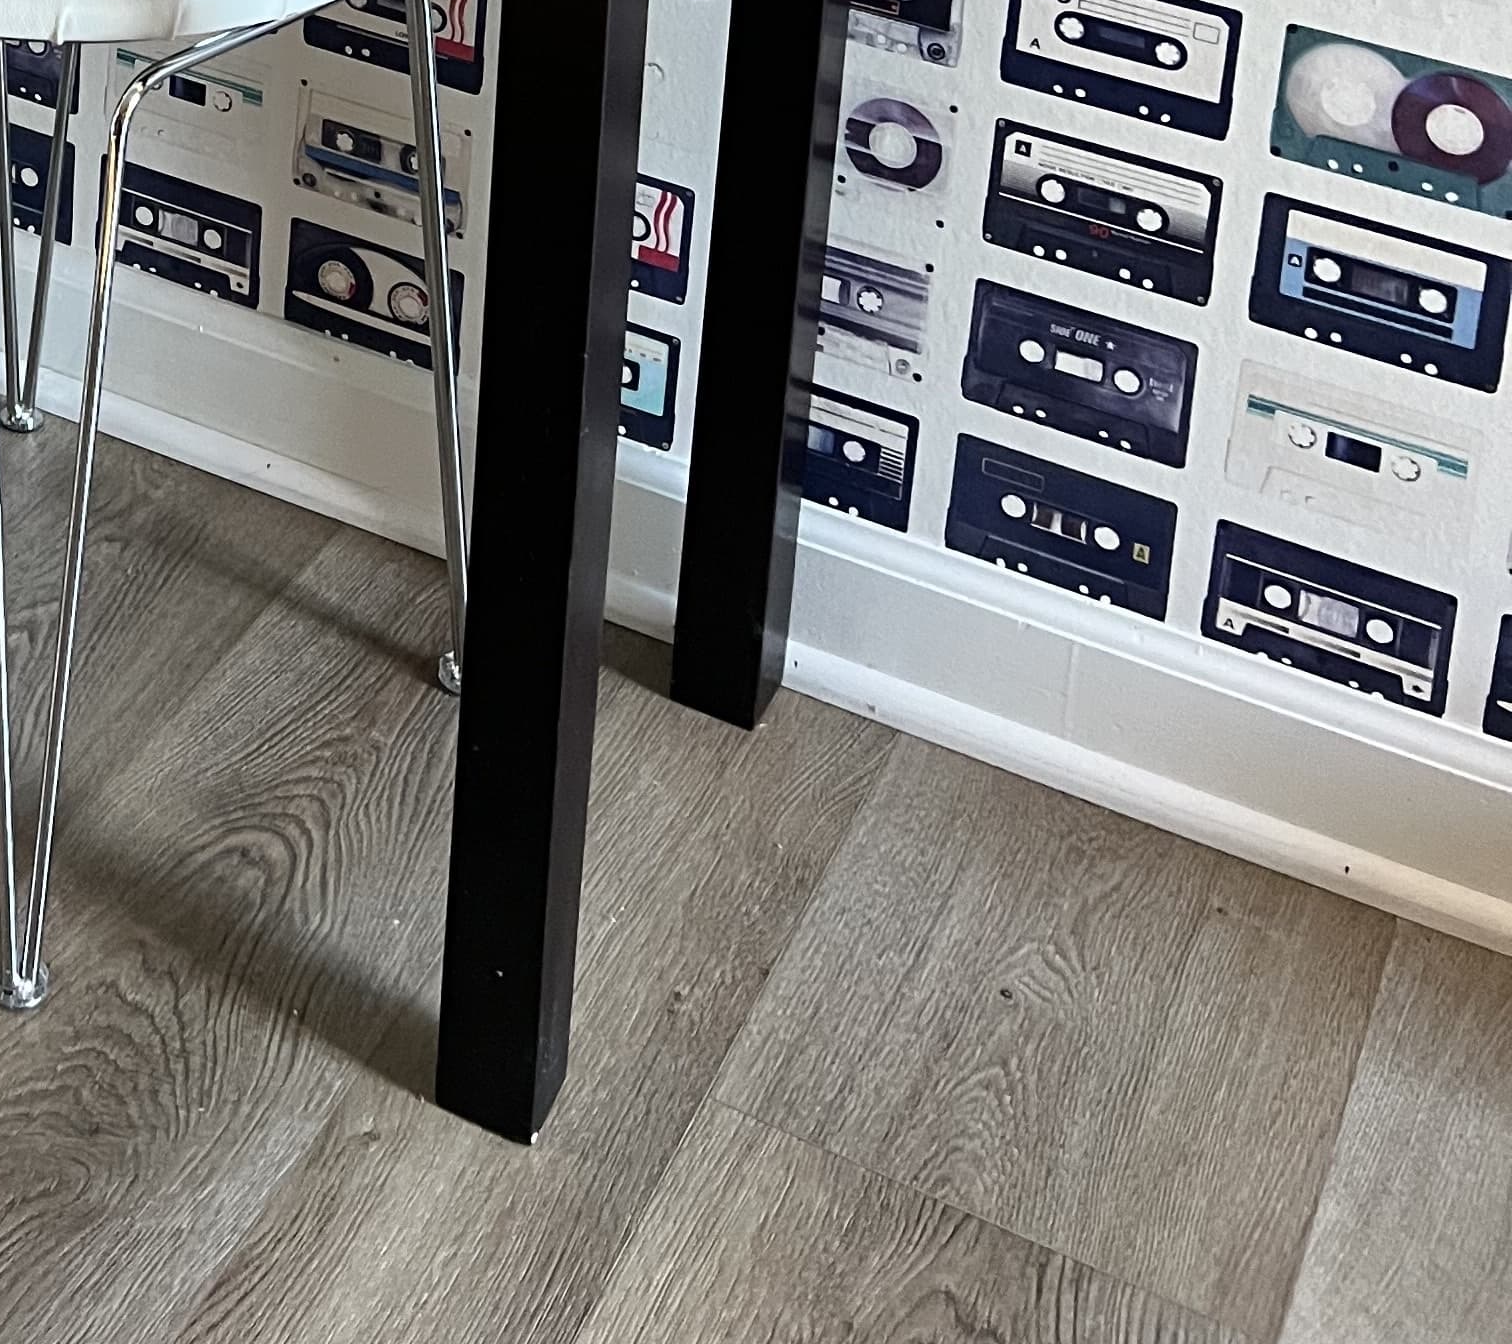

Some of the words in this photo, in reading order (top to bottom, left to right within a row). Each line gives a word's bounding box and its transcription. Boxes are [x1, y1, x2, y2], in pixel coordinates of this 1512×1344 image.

[1029, 38, 1041, 50] A
[1050, 324, 1075, 338] SIDE
[1075, 329, 1101, 346] ONE
[1223, 618, 1235, 630] A
